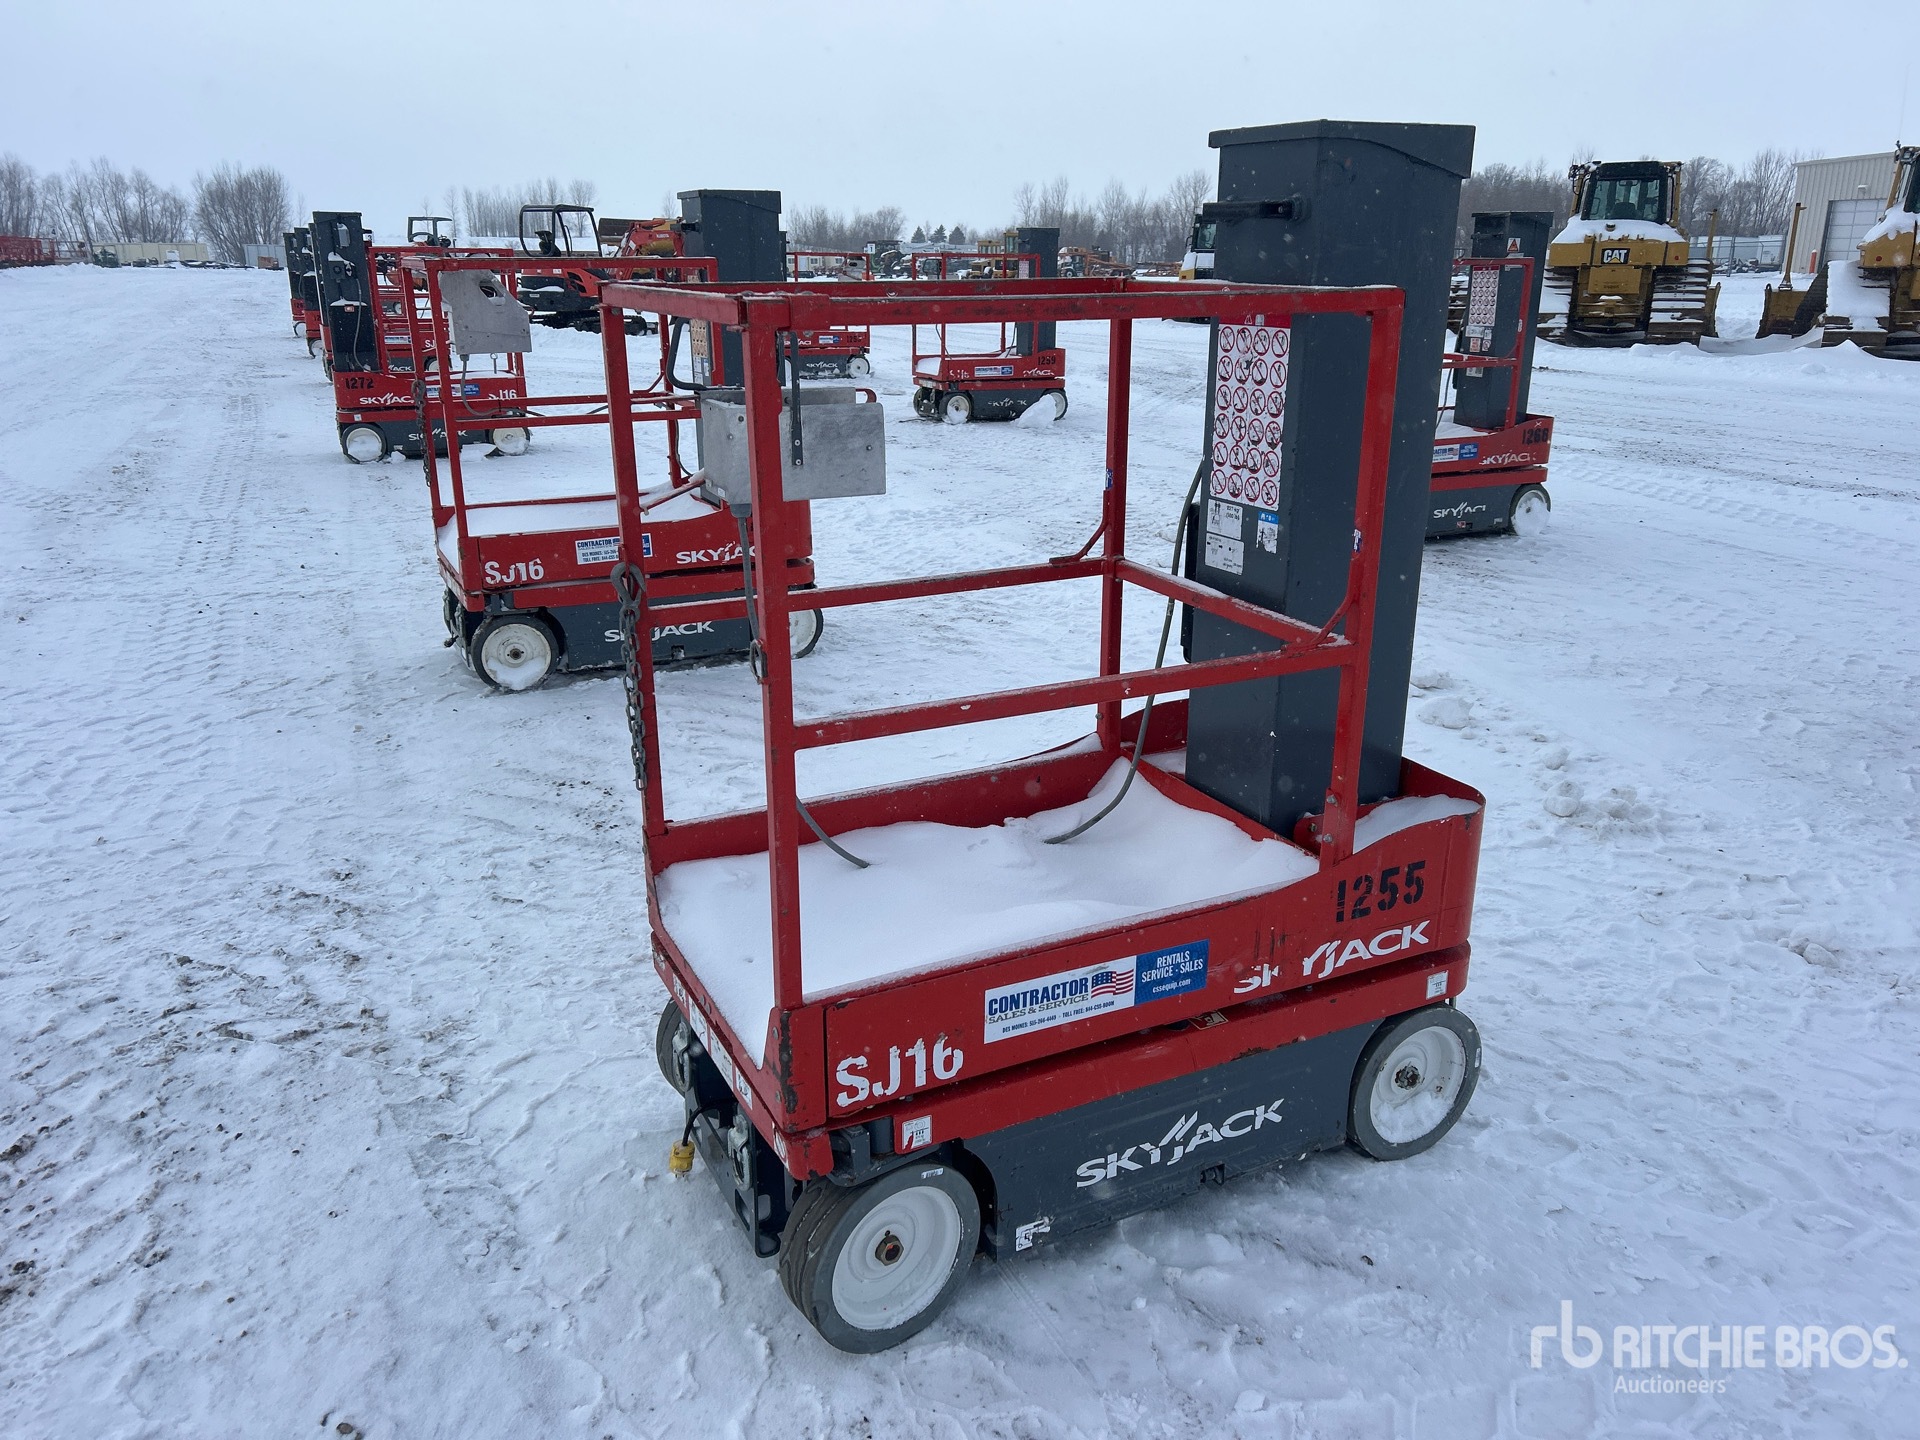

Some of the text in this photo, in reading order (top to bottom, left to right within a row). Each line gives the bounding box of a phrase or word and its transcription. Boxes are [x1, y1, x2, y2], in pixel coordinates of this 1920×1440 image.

[1603, 250, 1628, 263] CAT
[345, 377, 375, 390] 1272
[359, 392, 415, 405] SKYJAC
[577, 538, 612, 548] CONTRACTOR
[485, 558, 544, 584] SJ16
[1336, 860, 1426, 922] 1255
[1141, 958, 1204, 983] SERVICE SALES
[1156, 950, 1190, 969] RENTALS
[988, 977, 1089, 1016] CONTRACTOR
[1152, 978, 1191, 993] cssequip.com
[988, 994, 1089, 1024] SALES & SERVICE
[1062, 1010, 1073, 1018] TOLL
[836, 1035, 964, 1107] SJ16
[1076, 1098, 1285, 1188] SKYJACK
